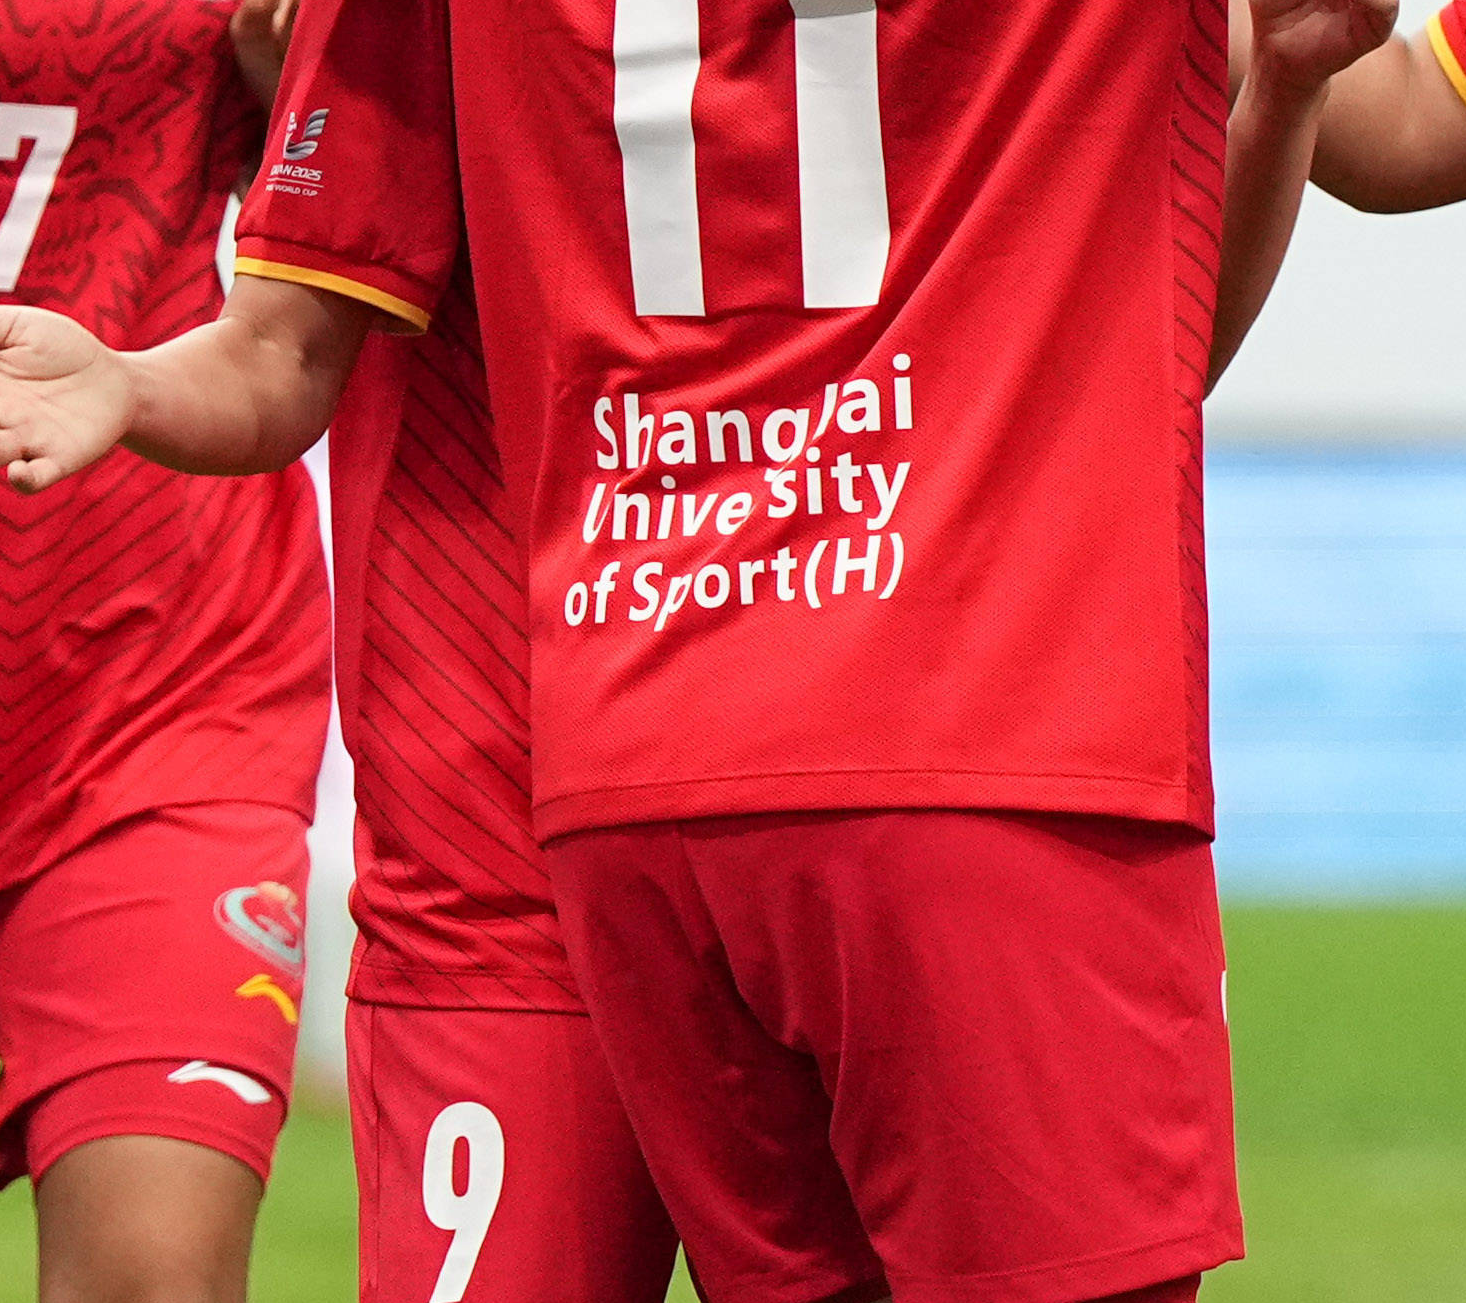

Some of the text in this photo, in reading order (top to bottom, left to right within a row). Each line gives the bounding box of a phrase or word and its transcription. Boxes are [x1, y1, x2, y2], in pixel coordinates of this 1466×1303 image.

[291, 165, 322, 181] 2025
[302, 188, 319, 197] CUP
[582, 446, 912, 545] Univesity
[564, 532, 906, 633] of Sport(H)
